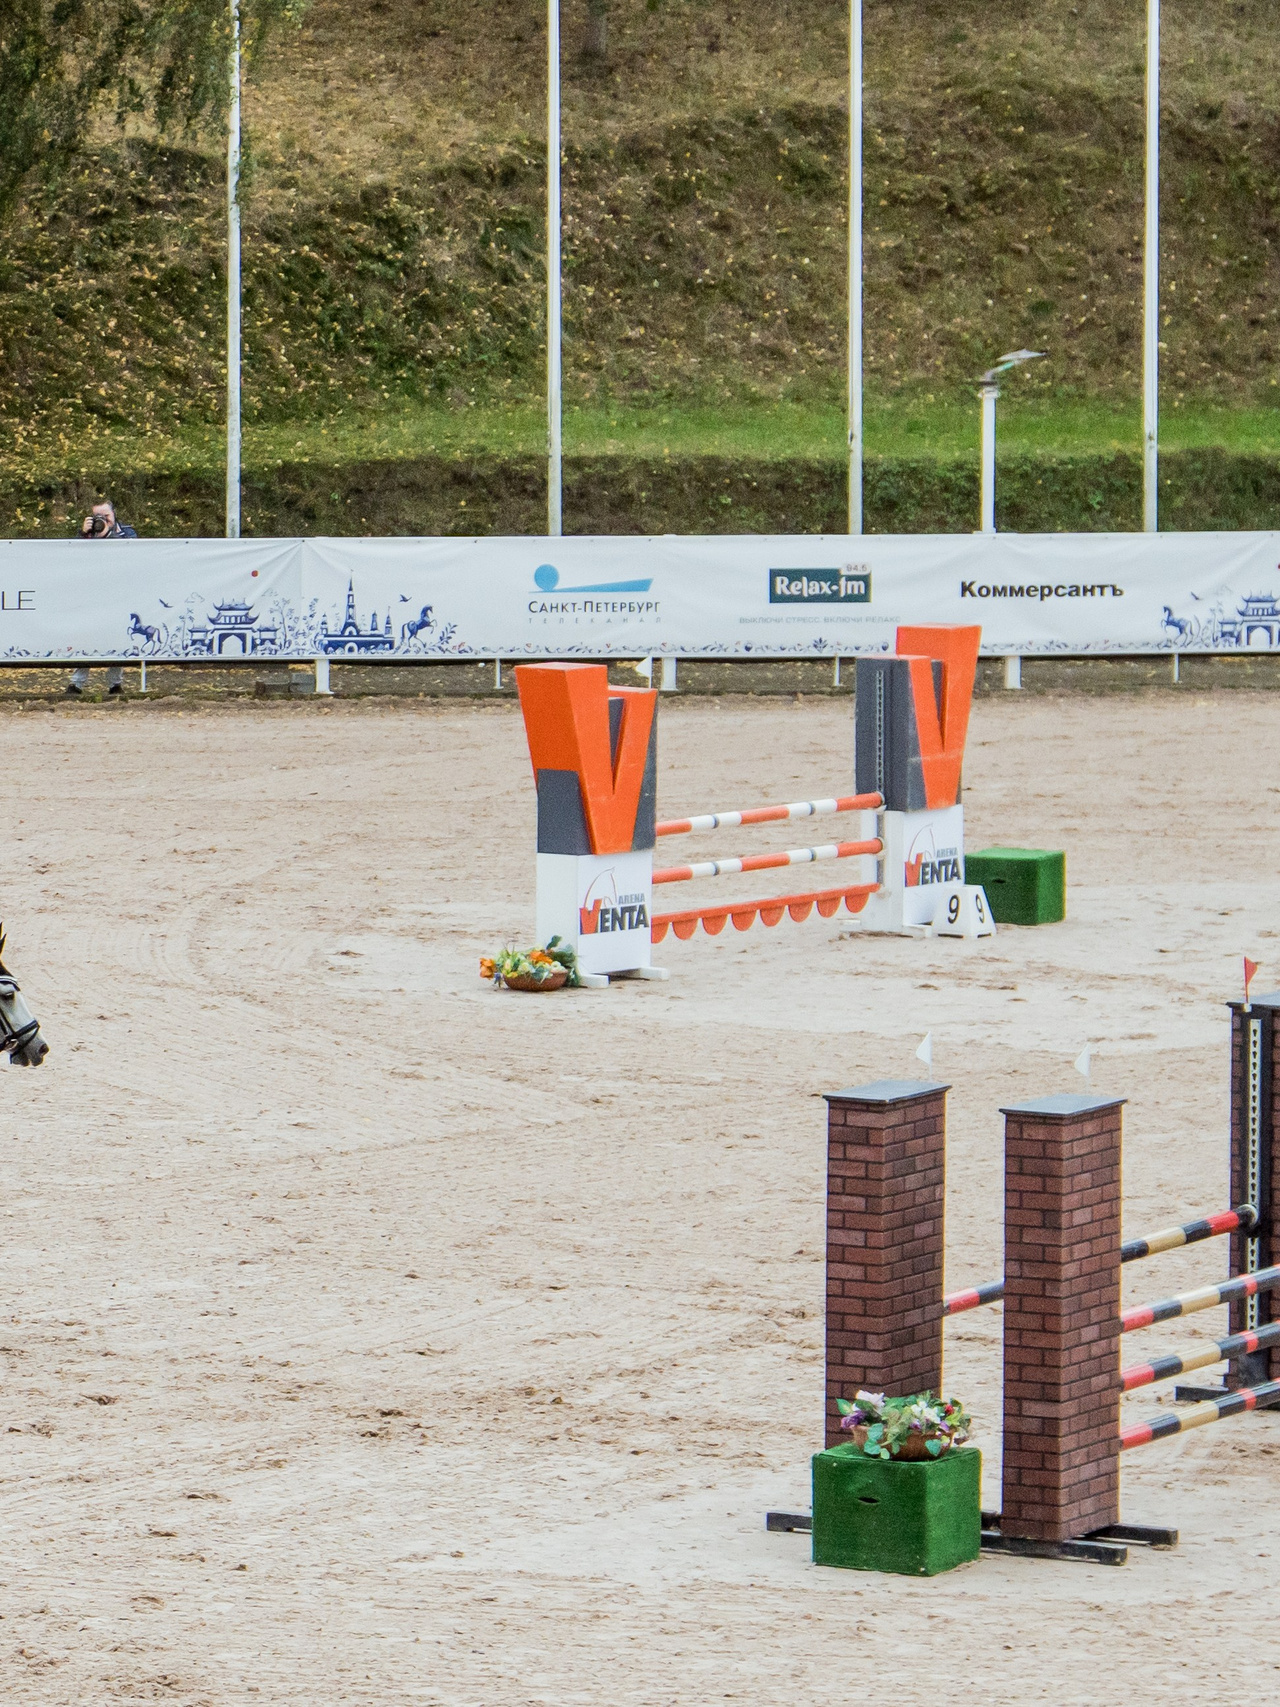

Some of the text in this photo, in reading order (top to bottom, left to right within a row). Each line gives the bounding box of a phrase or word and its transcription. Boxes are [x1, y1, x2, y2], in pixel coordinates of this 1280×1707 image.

[960, 581, 1124, 601] Коммерсантъ
[618, 893, 646, 905] ARENA
[947, 894, 961, 925] 9
[975, 893, 985, 924] 9
